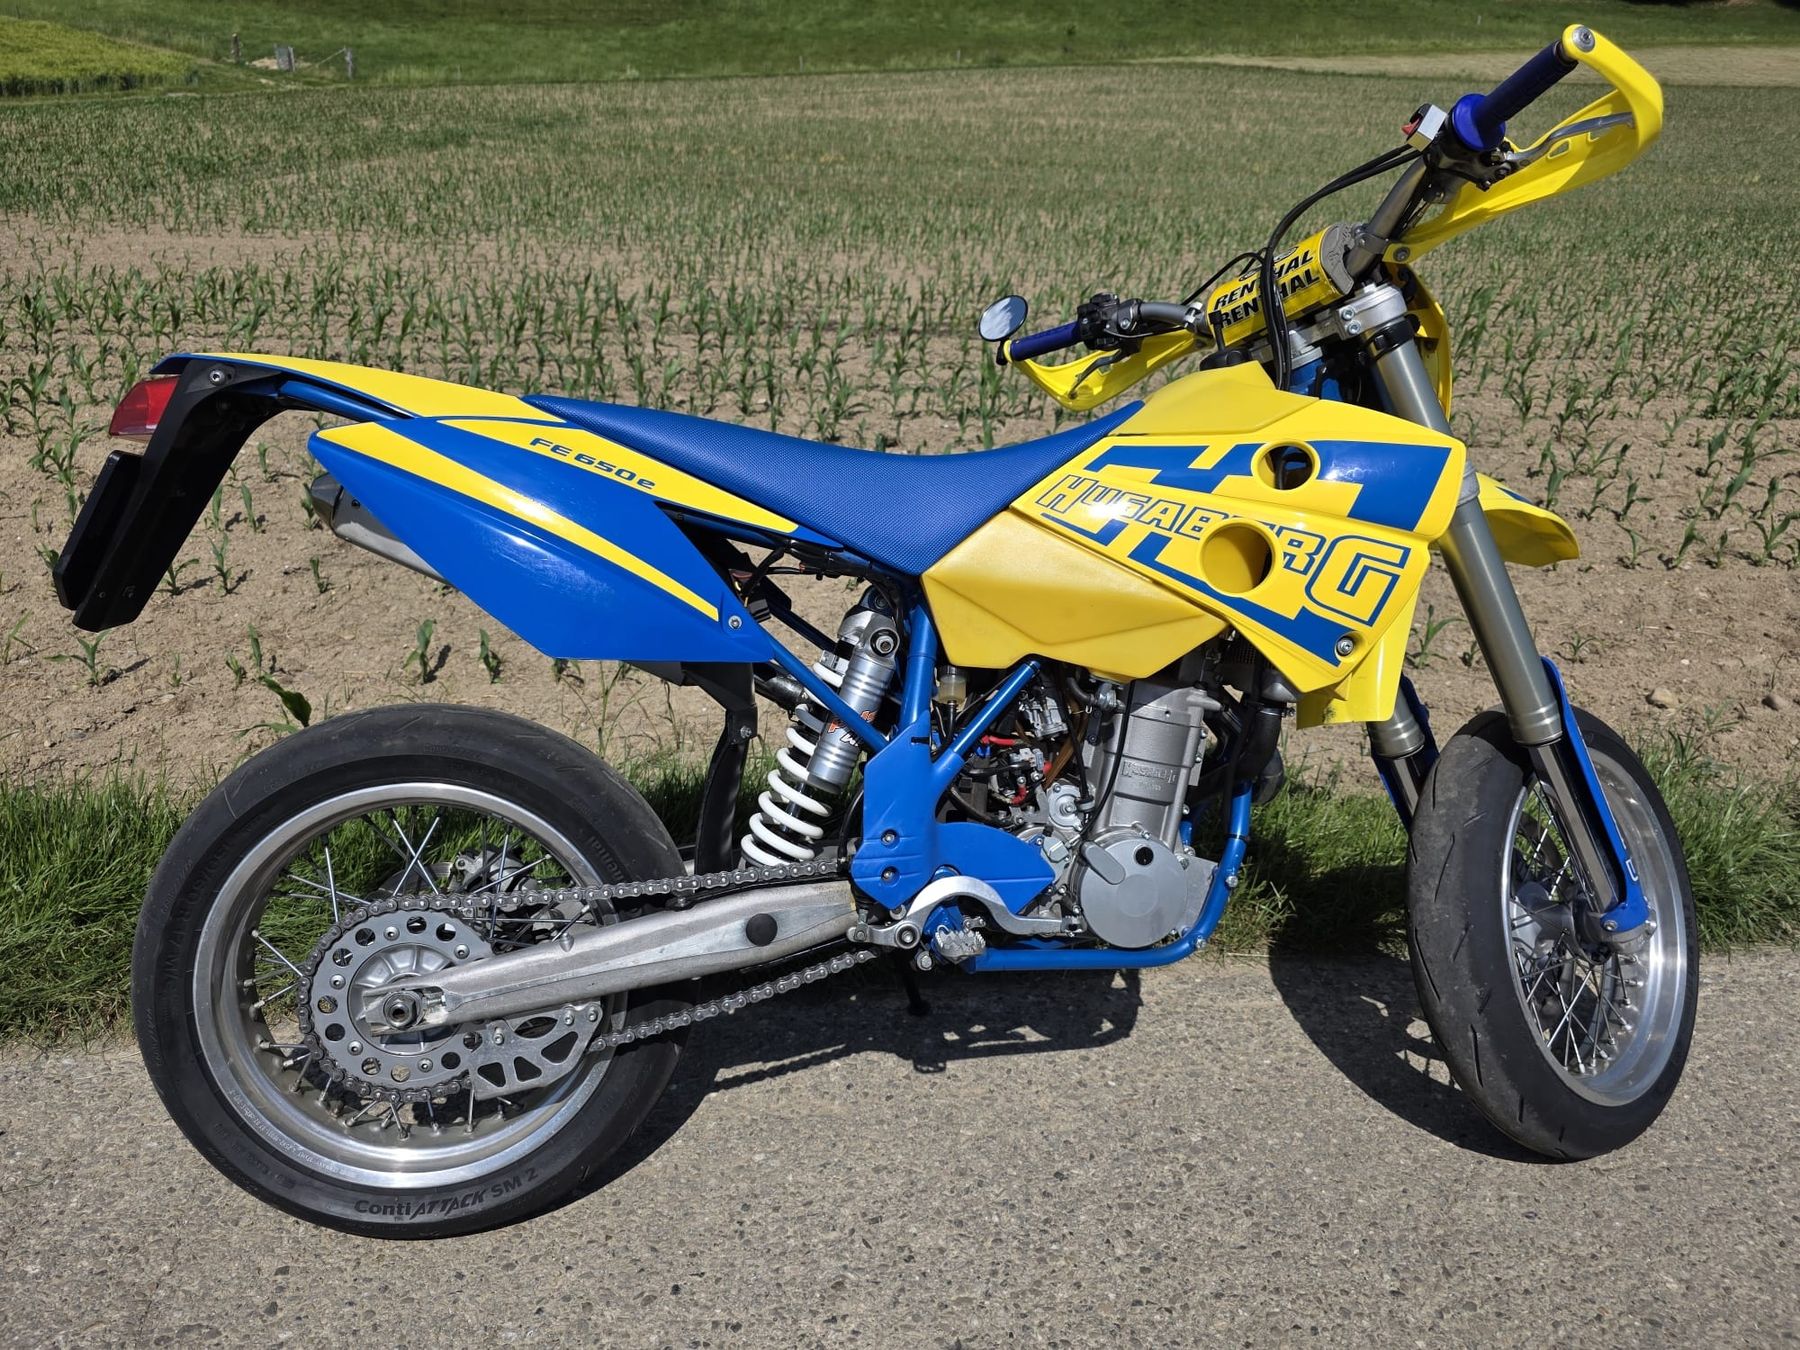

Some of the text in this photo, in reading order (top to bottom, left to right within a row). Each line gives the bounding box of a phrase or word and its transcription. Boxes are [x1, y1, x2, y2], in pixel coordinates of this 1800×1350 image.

[1214, 250, 1314, 310] RENHAL
[1219, 269, 1321, 328] RENHAL
[529, 437, 573, 457] FE
[1035, 474, 1411, 628] HUSABRG
[490, 1175, 523, 1199] SM
[526, 1167, 539, 1181] 2
